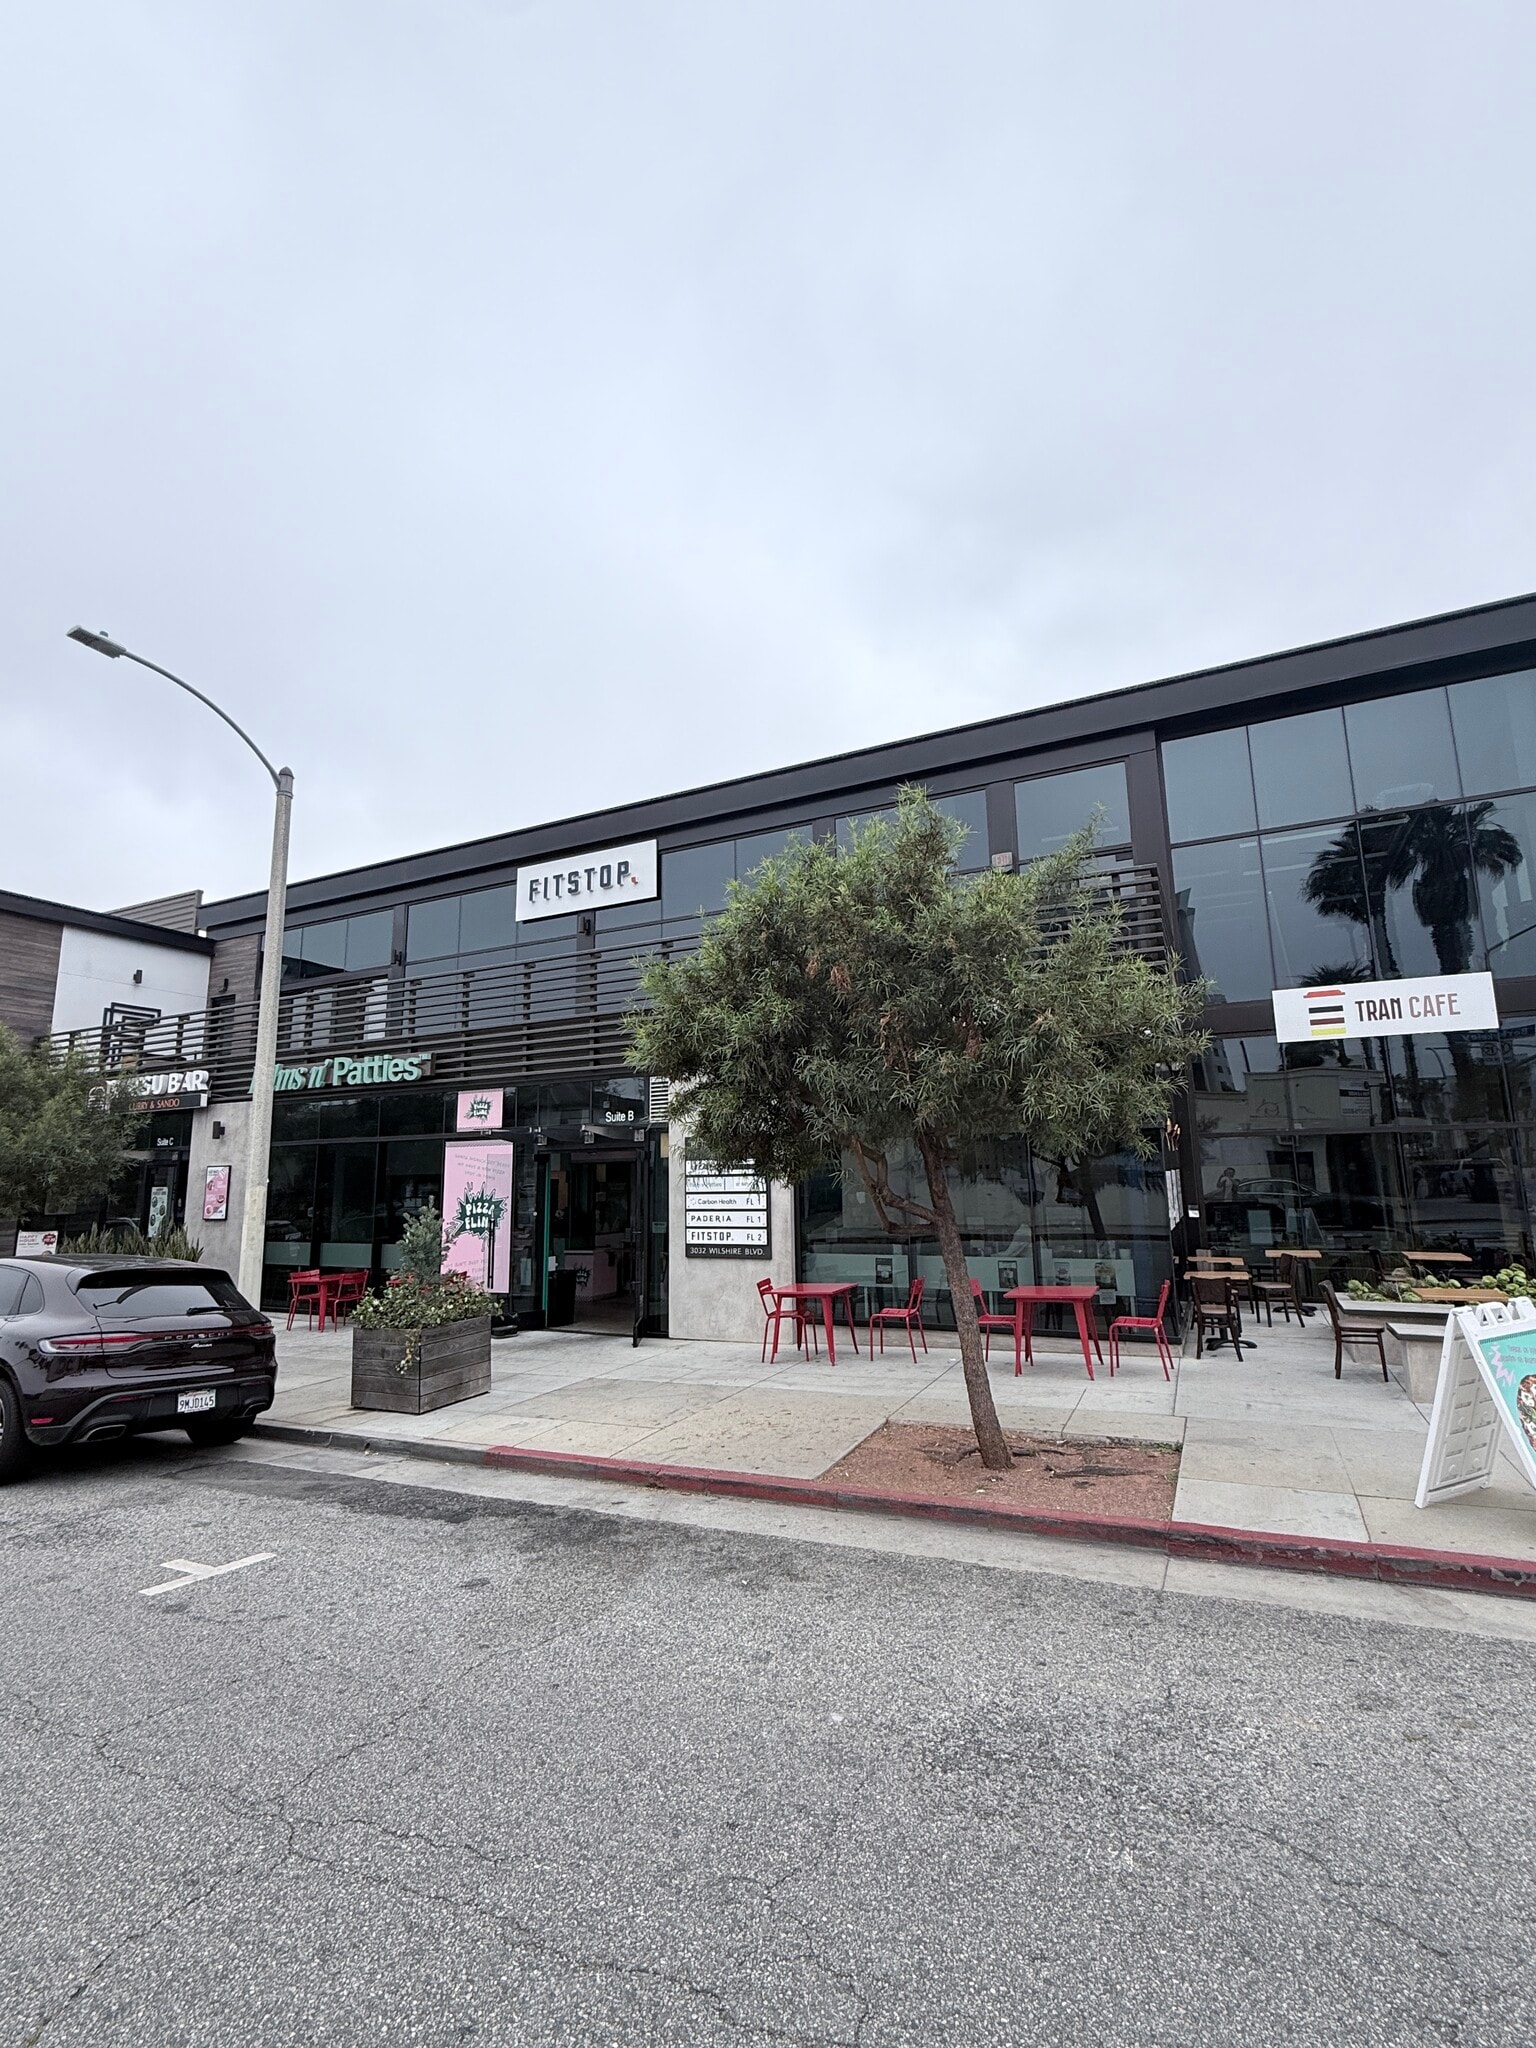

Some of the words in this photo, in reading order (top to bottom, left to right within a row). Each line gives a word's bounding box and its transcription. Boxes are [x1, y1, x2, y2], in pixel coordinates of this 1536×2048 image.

[1355, 997, 1403, 1022] TRAN
[1408, 993, 1461, 1019] CAFE
[333, 1054, 422, 1086] Patties
[150, 1100, 155, 1109] &
[157, 1098, 180, 1109] SANDO
[605, 1111, 626, 1122] Suite
[627, 1110, 634, 1121] B
[168, 1137, 174, 1146] C
[746, 1198, 754, 1206] FL
[465, 1202, 495, 1216] PIZZA
[465, 1216, 495, 1230] FLIN
[691, 1215, 732, 1223] PADERIA
[691, 1231, 734, 1241] FITSTOP.
[709, 1247, 742, 1255] WILSHIRE
[744, 1248, 765, 1256] BLVD.
